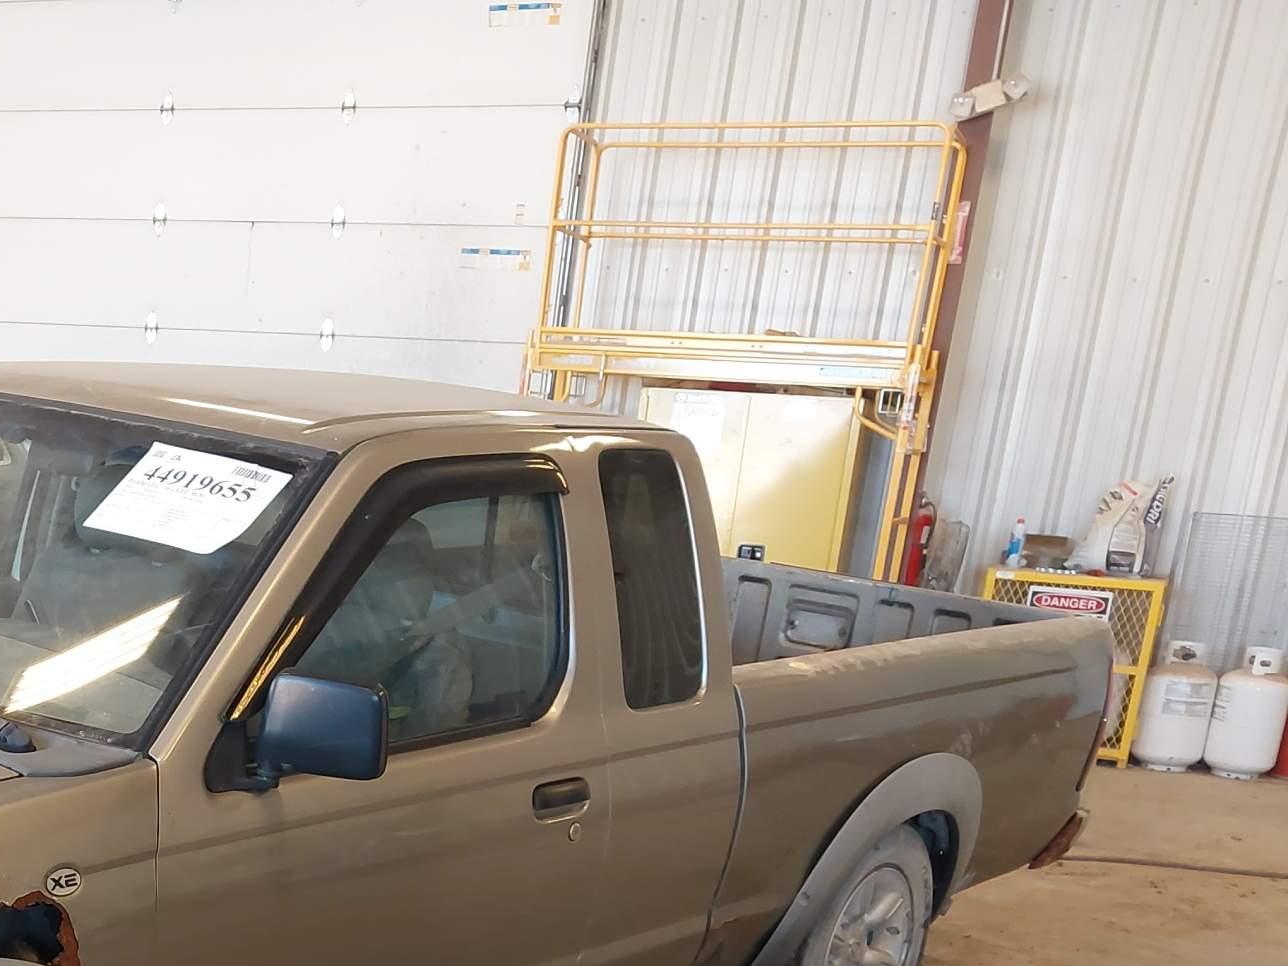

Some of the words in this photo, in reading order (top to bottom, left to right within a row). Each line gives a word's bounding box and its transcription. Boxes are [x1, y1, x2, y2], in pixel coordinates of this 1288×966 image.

[143, 465, 257, 502] 44919655
[1041, 595, 1098, 610] DANGER
[50, 872, 78, 891] XE
